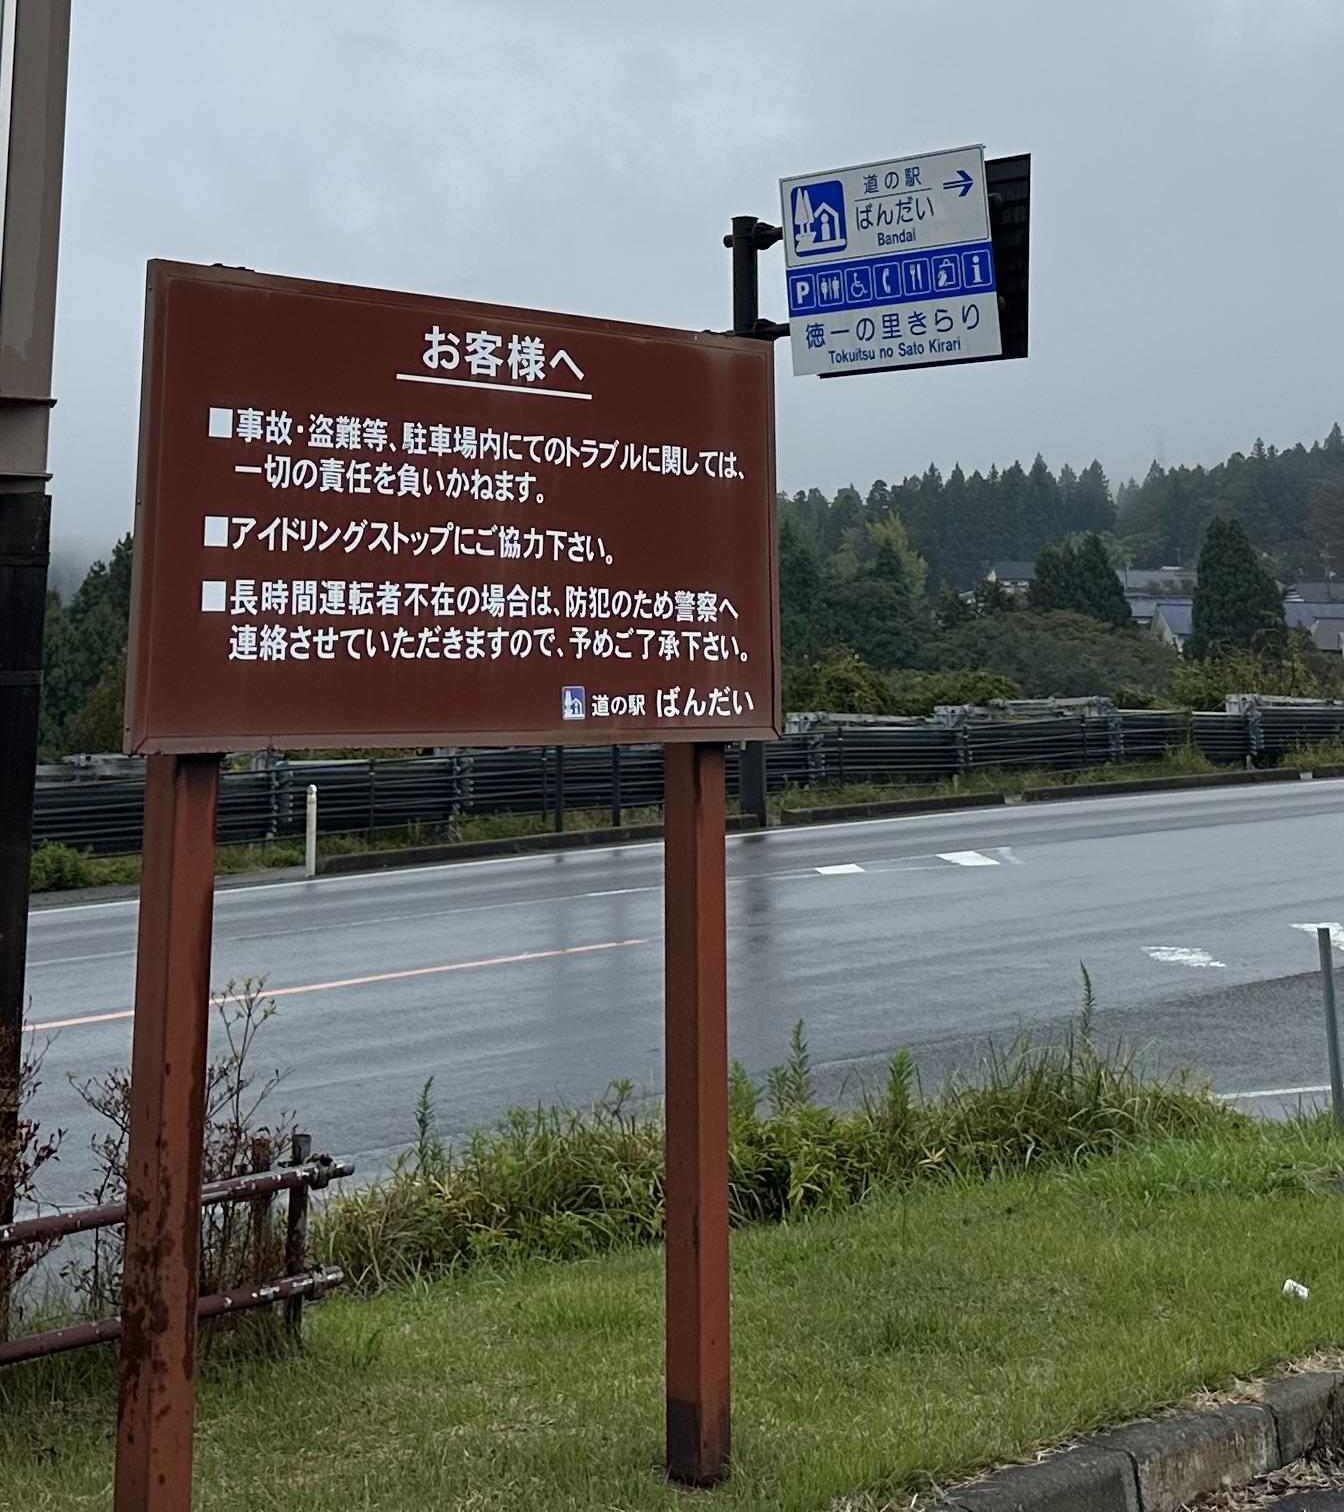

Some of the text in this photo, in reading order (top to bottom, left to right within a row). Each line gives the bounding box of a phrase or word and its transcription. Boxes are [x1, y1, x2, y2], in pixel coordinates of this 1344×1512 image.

[863, 167, 922, 194] 道の駅
[855, 196, 935, 231] ばんだい
[877, 227, 917, 246] Bandai
[805, 303, 980, 350] 徳一の里きらり
[422, 326, 585, 382] お客様へ
[828, 335, 961, 365] Tokuitsu no Sato Kirari
[234, 454, 544, 504] 一切の責任を負いかねます。
[231, 516, 615, 565] アイドリングストップにご協力下さい。
[229, 579, 739, 623] 長時間運転者不在の場合は、防犯のため警察へ
[228, 624, 748, 662] 連絡させていただきますので、予めご了承下さい。
[591, 685, 755, 718] 道の駅 ばんだい
